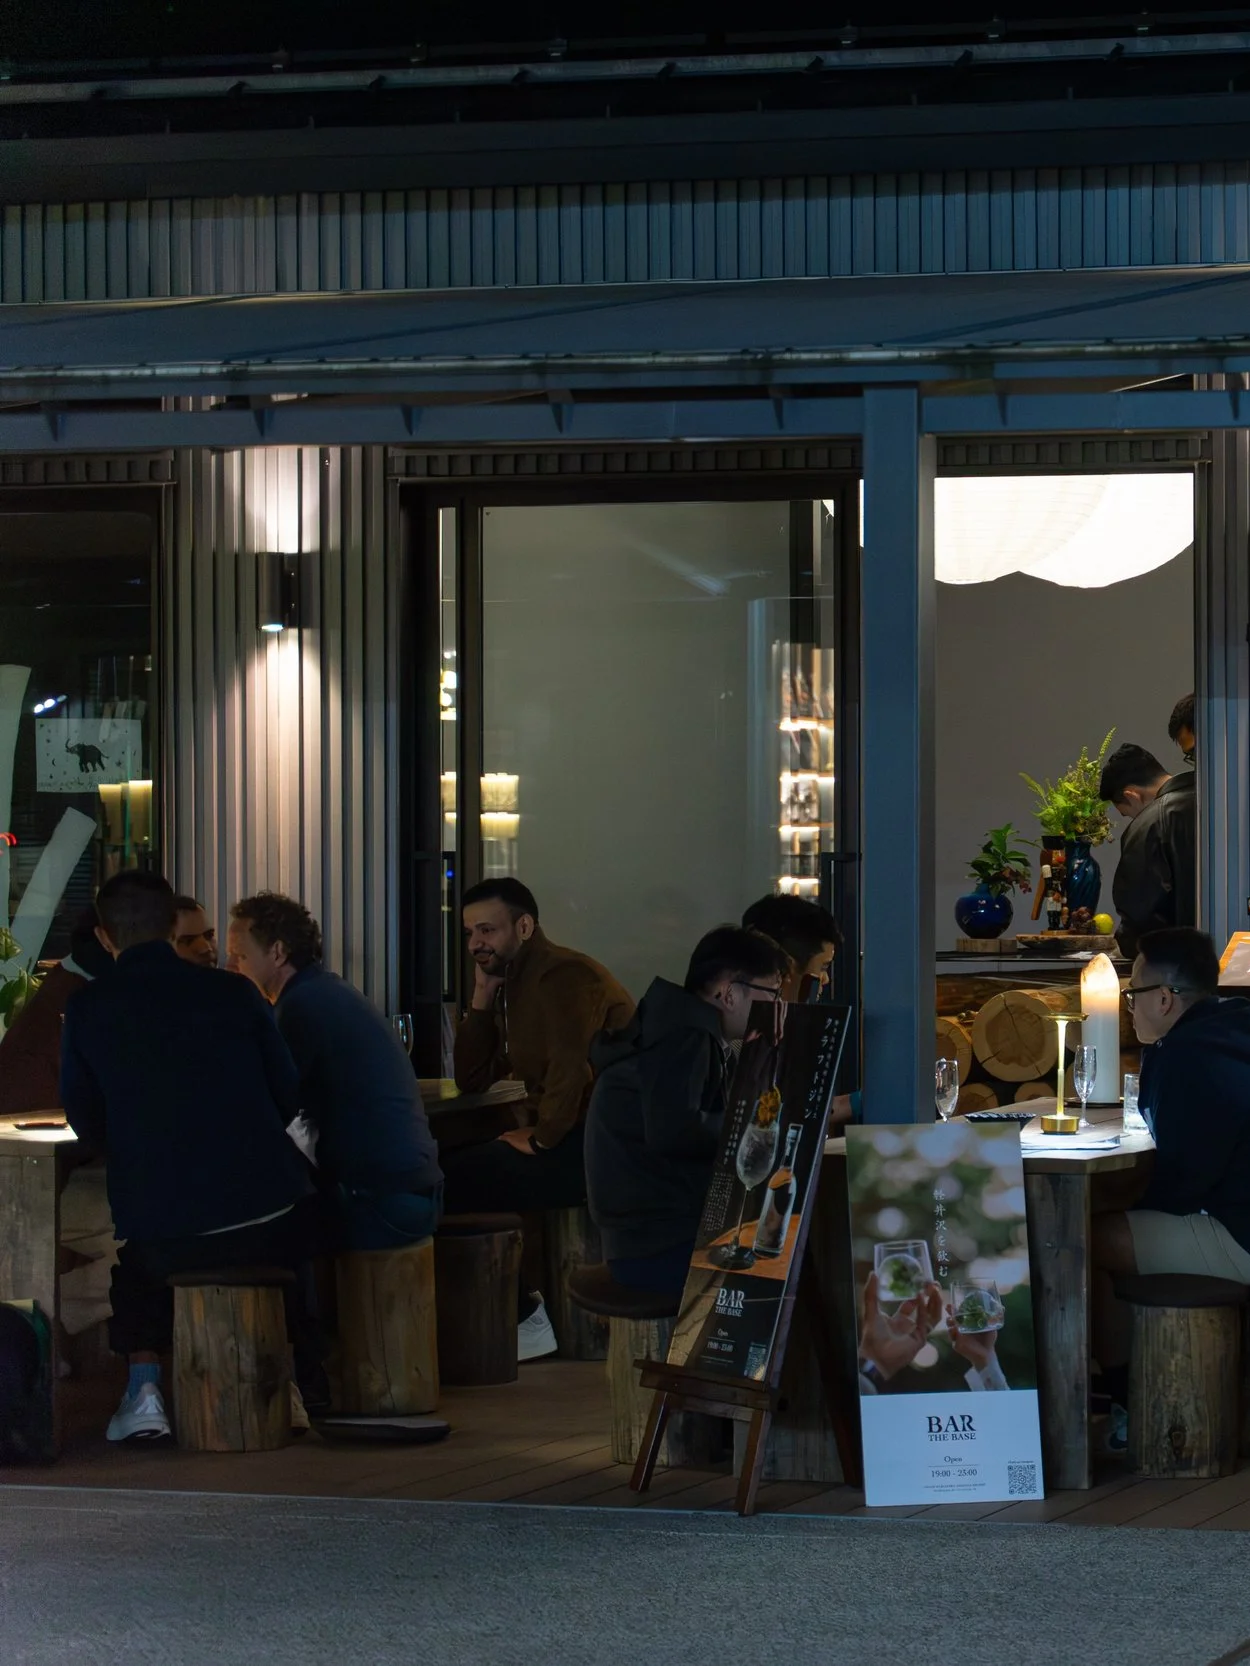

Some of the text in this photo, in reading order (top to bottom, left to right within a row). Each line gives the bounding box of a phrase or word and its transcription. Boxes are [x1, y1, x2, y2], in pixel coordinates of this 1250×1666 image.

[804, 1017, 833, 1120] クラフトジン
[933, 1188, 950, 1277] 軽井沢を飲む
[716, 1288, 745, 1309] BAR
[715, 1305, 743, 1317] THE BASE
[926, 1414, 977, 1433] BAR
[928, 1432, 976, 1442] THE BASE
[943, 1455, 963, 1464] Open
[931, 1470, 951, 1478] 19:00
